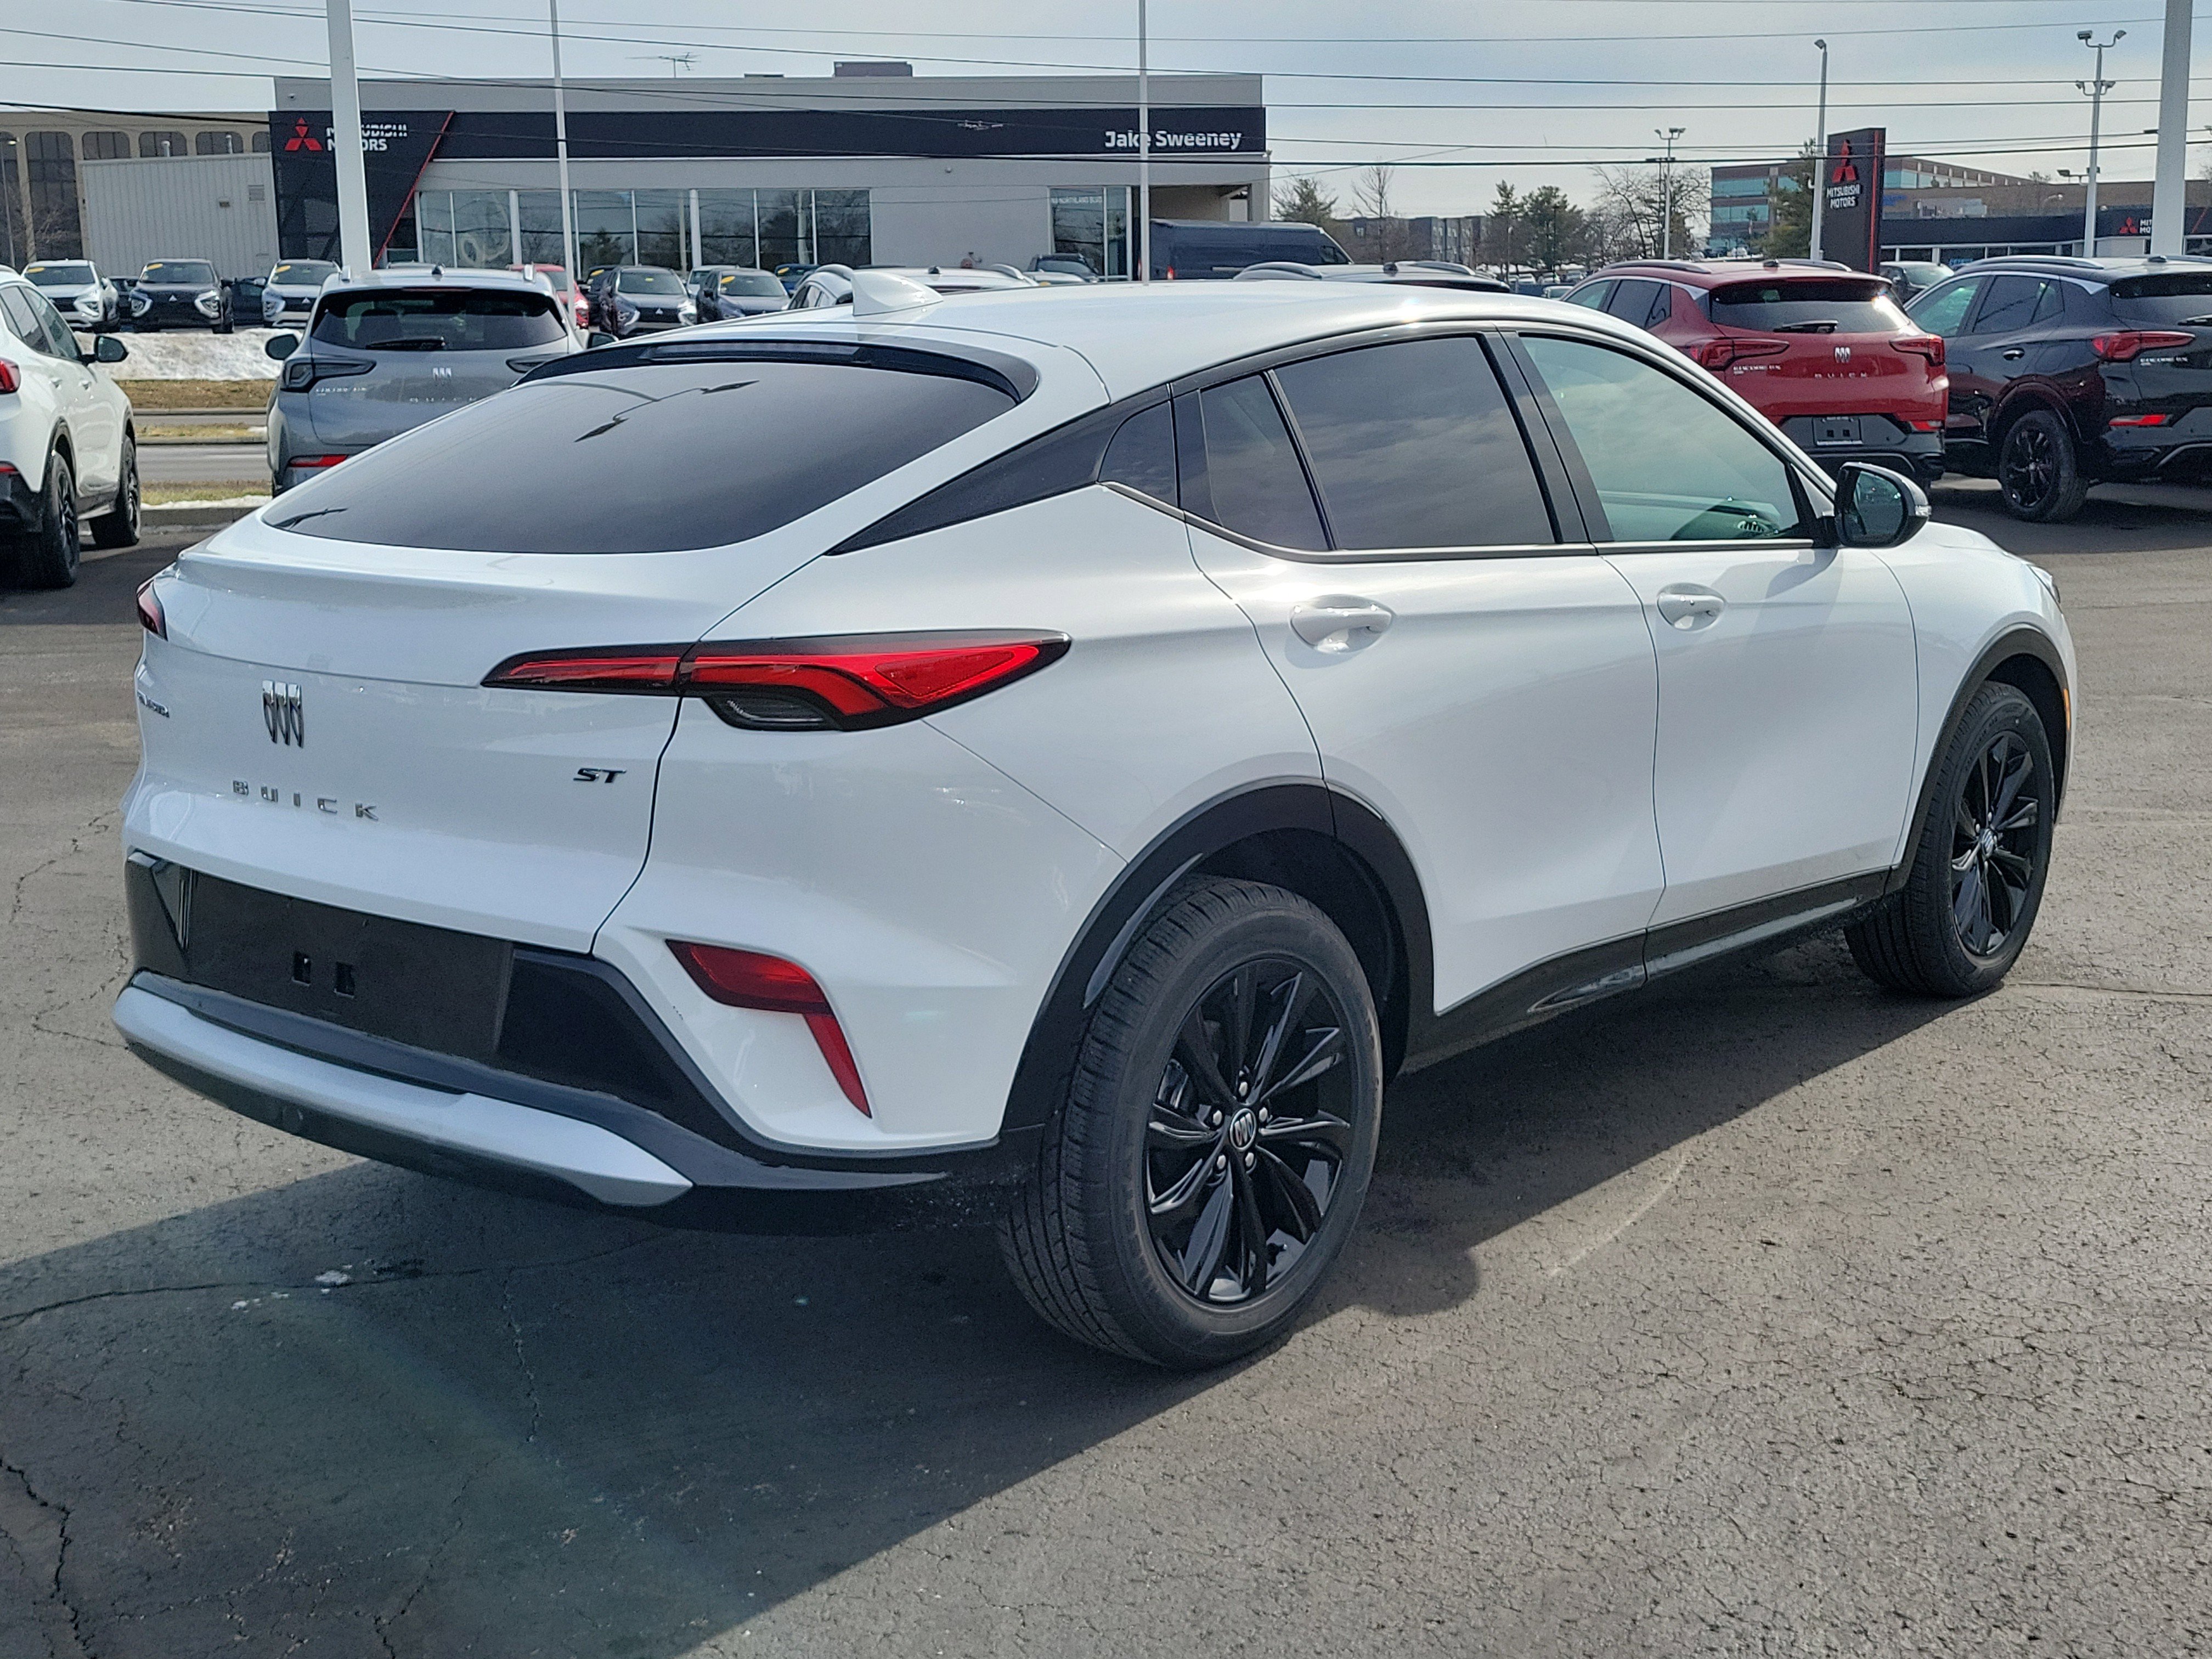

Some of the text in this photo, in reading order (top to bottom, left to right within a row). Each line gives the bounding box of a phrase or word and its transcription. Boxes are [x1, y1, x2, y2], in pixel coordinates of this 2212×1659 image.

[1155, 131, 1242, 150] Sweeney
[1826, 184, 1860, 198] MITSUBISHI
[1830, 196, 1856, 208] MOTORS
[573, 768, 627, 783] ST
[233, 780, 379, 821] BUICK
